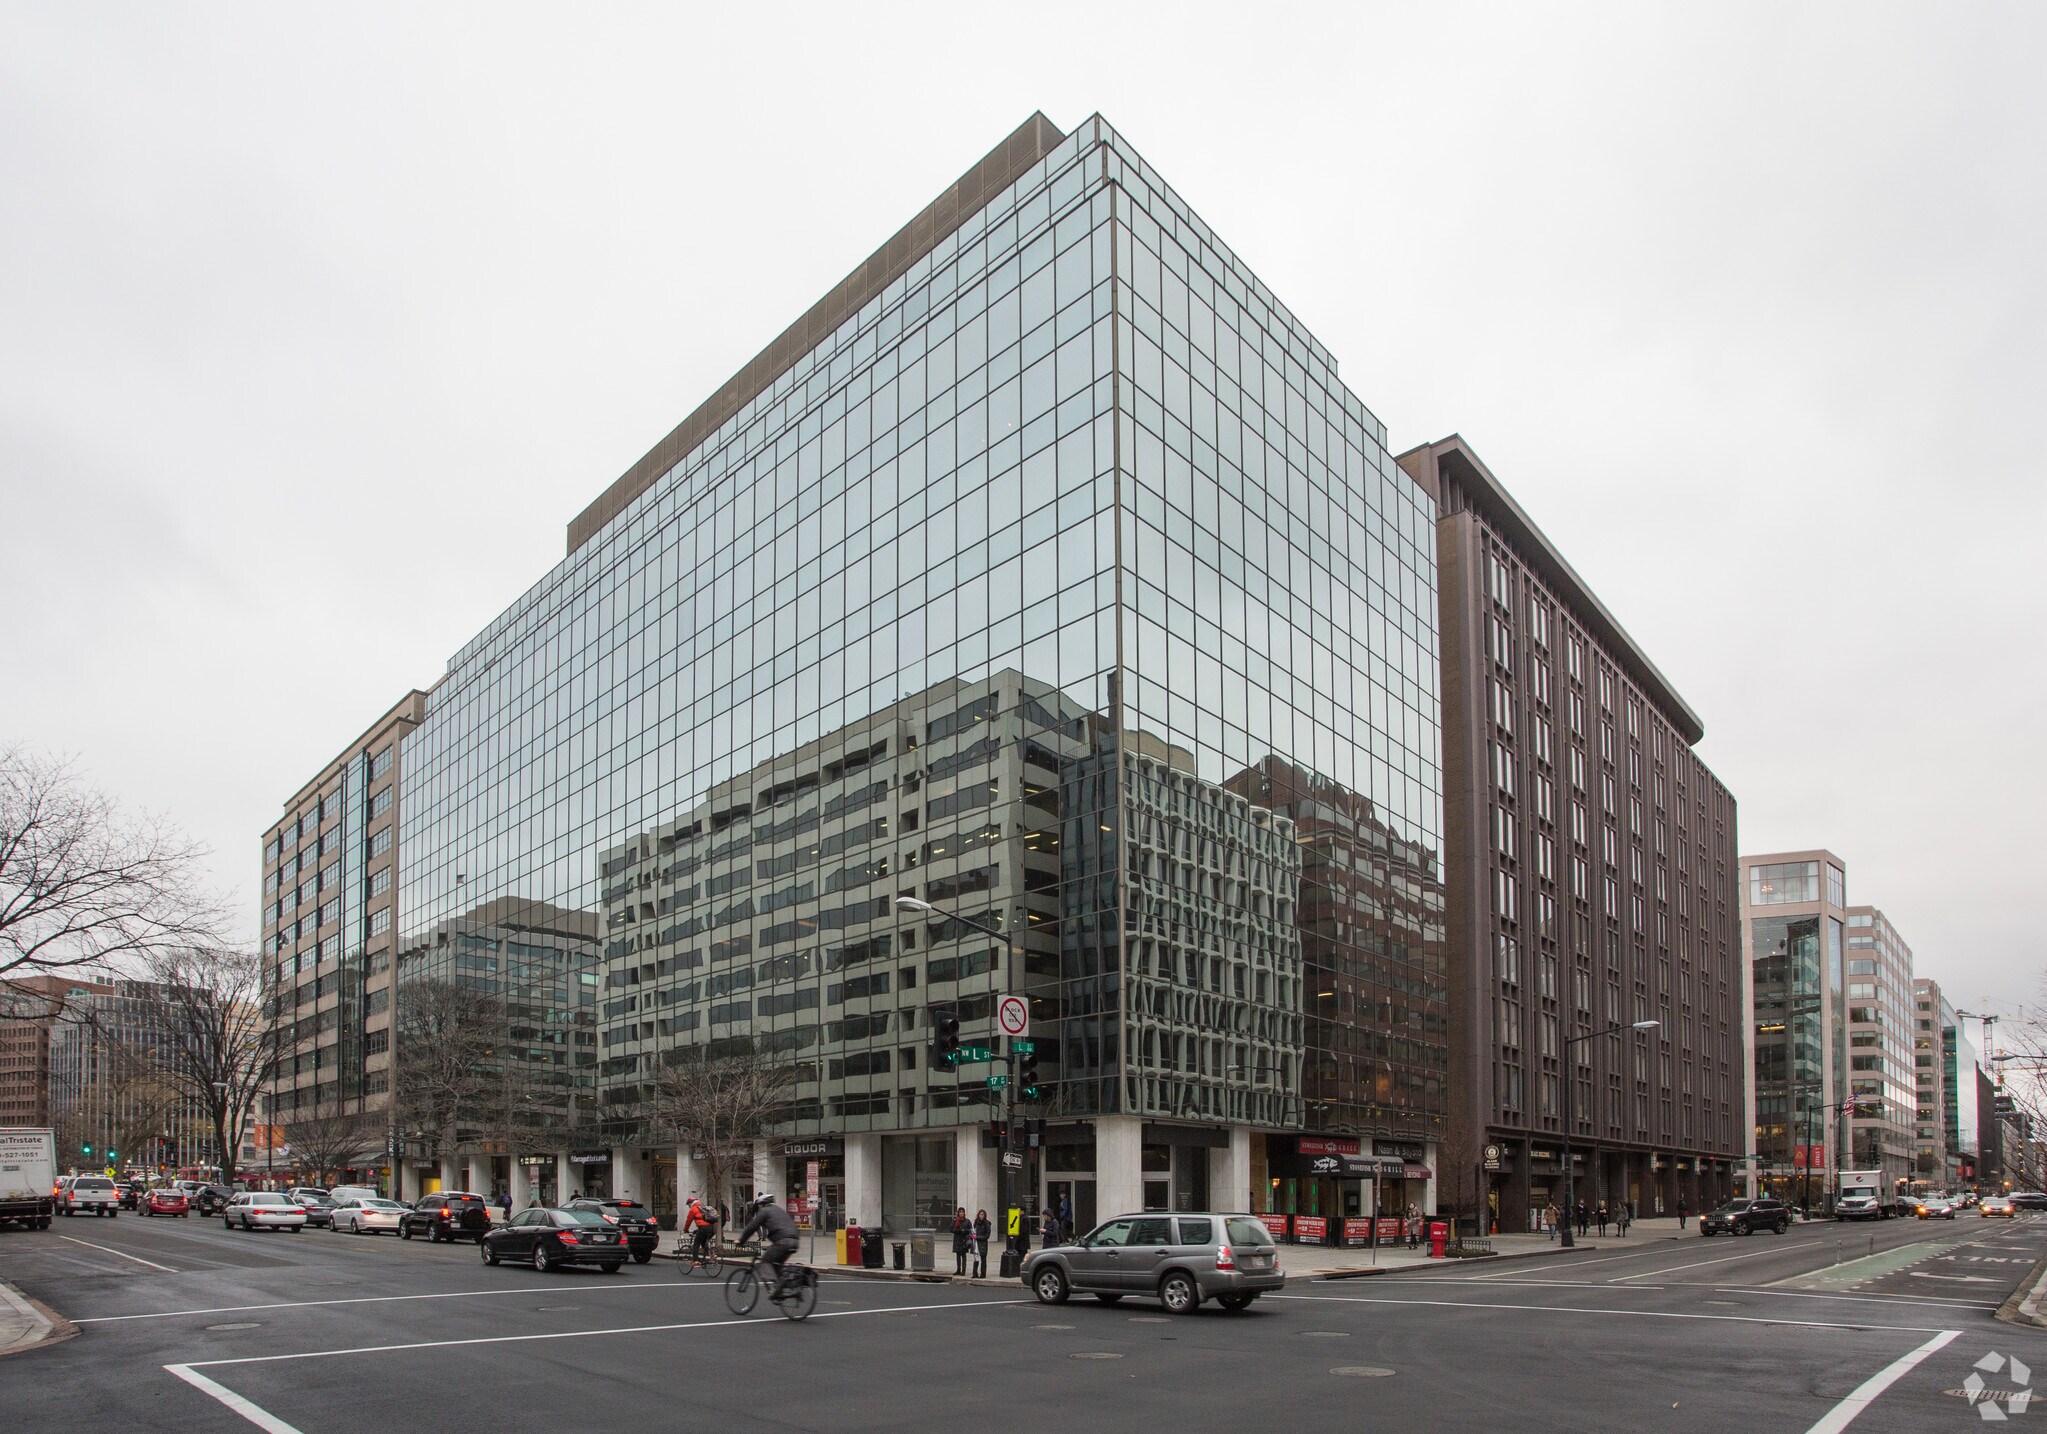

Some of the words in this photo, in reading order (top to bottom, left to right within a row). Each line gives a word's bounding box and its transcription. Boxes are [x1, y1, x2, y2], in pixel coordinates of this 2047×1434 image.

[1018, 1043, 1023, 1051] L
[961, 1049, 969, 1057] NW
[973, 1048, 979, 1060] L
[983, 1051, 990, 1059] ST
[991, 1077, 998, 1085] 17
[784, 1144, 826, 1154] LIQUOR
[1378, 1145, 1393, 1155] Naan
[1395, 1146, 1399, 1155] &
[1402, 1147, 1422, 1158] Beyond
[1383, 1165, 1402, 1173] GRILL
